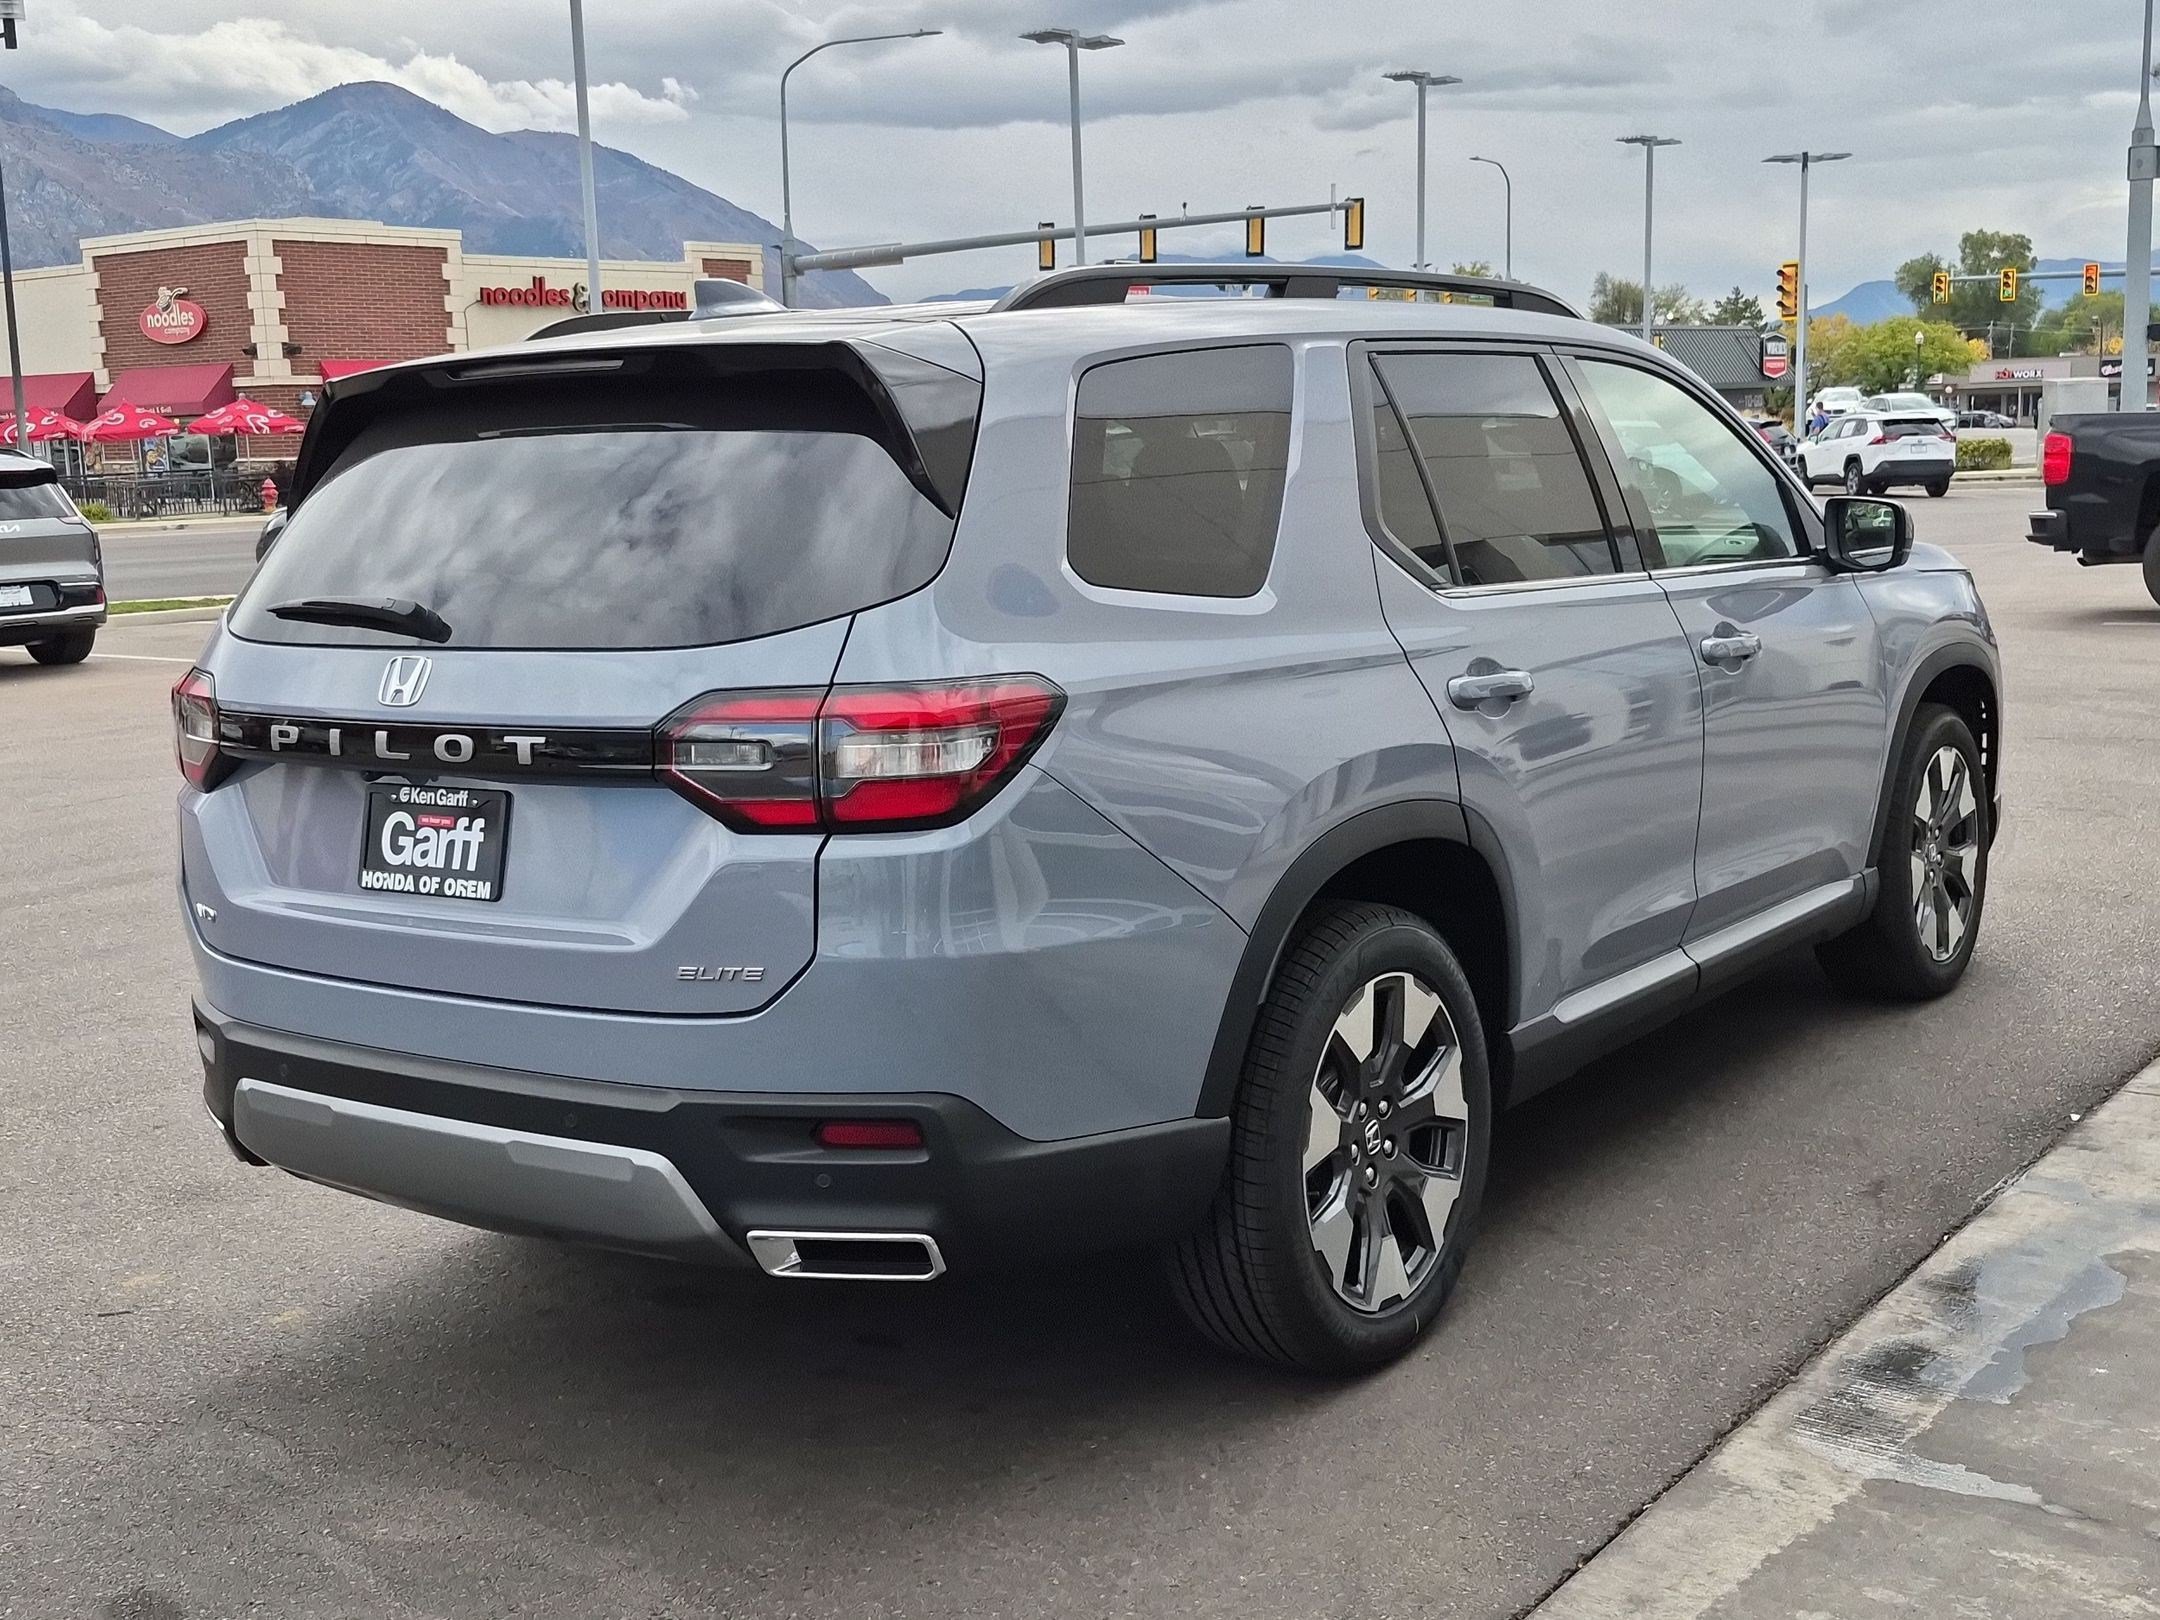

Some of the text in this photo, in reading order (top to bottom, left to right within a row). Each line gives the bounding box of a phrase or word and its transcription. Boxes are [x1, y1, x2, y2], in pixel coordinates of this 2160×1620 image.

[481, 276, 569, 308] noodles
[602, 289, 686, 309] ompany
[146, 303, 194, 328] noodles
[271, 724, 546, 765] PILOT
[411, 787, 469, 807] Ken Garff
[381, 811, 485, 871] Garff
[361, 871, 491, 899] HONDA OF OREM
[678, 966, 765, 981] ELITE
